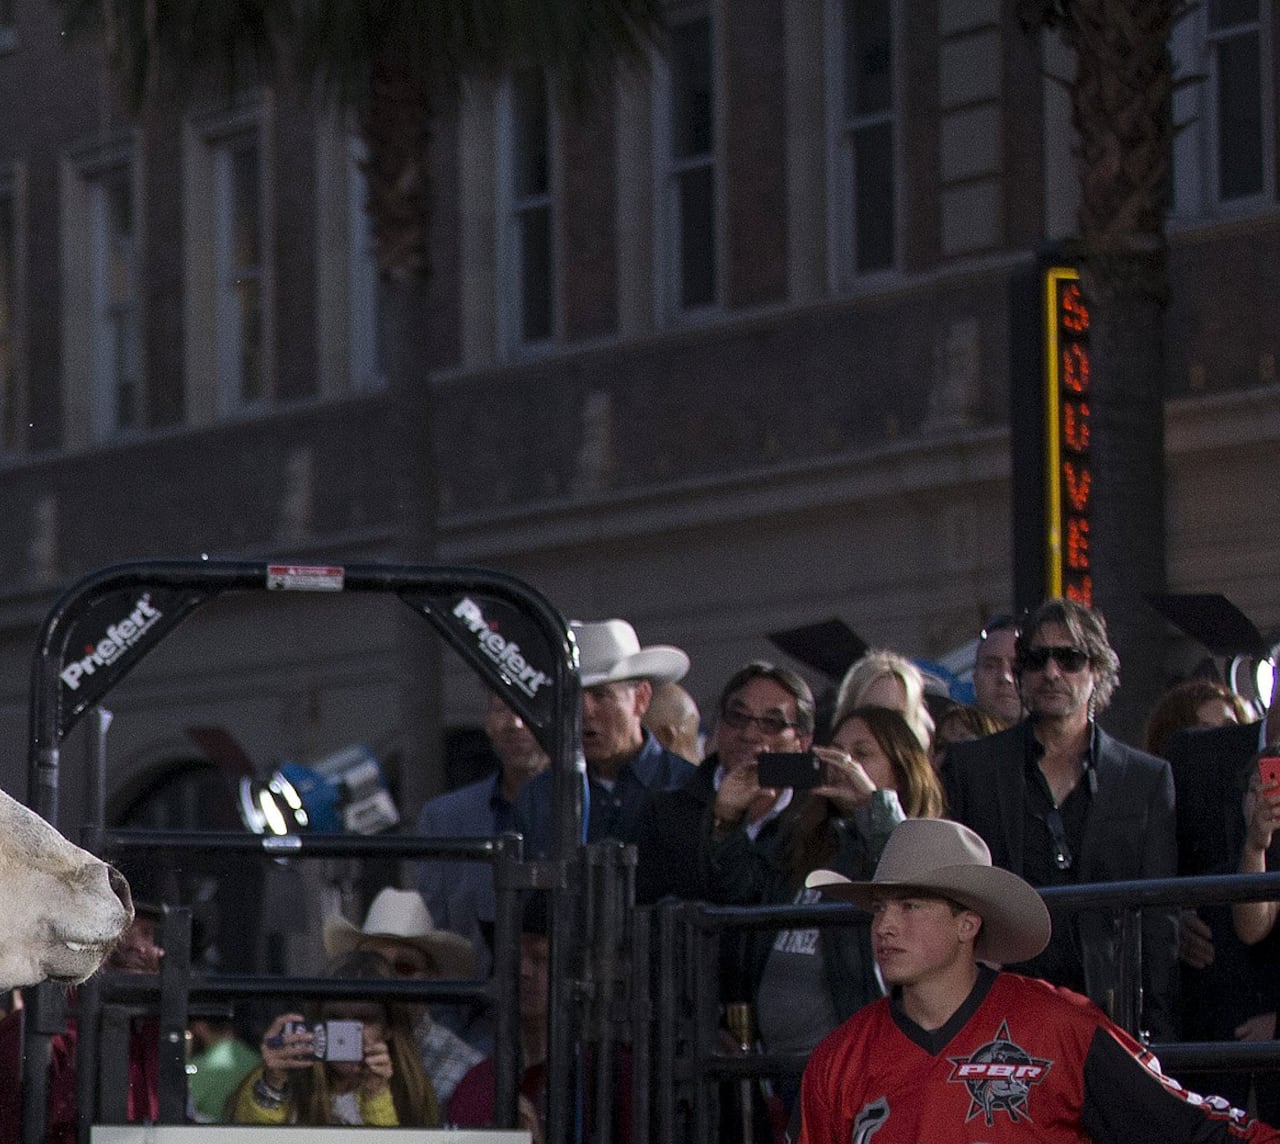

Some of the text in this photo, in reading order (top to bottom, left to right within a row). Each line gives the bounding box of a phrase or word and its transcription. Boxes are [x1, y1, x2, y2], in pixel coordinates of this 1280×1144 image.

[60, 597, 158, 691] Priefert
[453, 597, 547, 693] Priefert
[958, 1064, 1042, 1078] PBR
